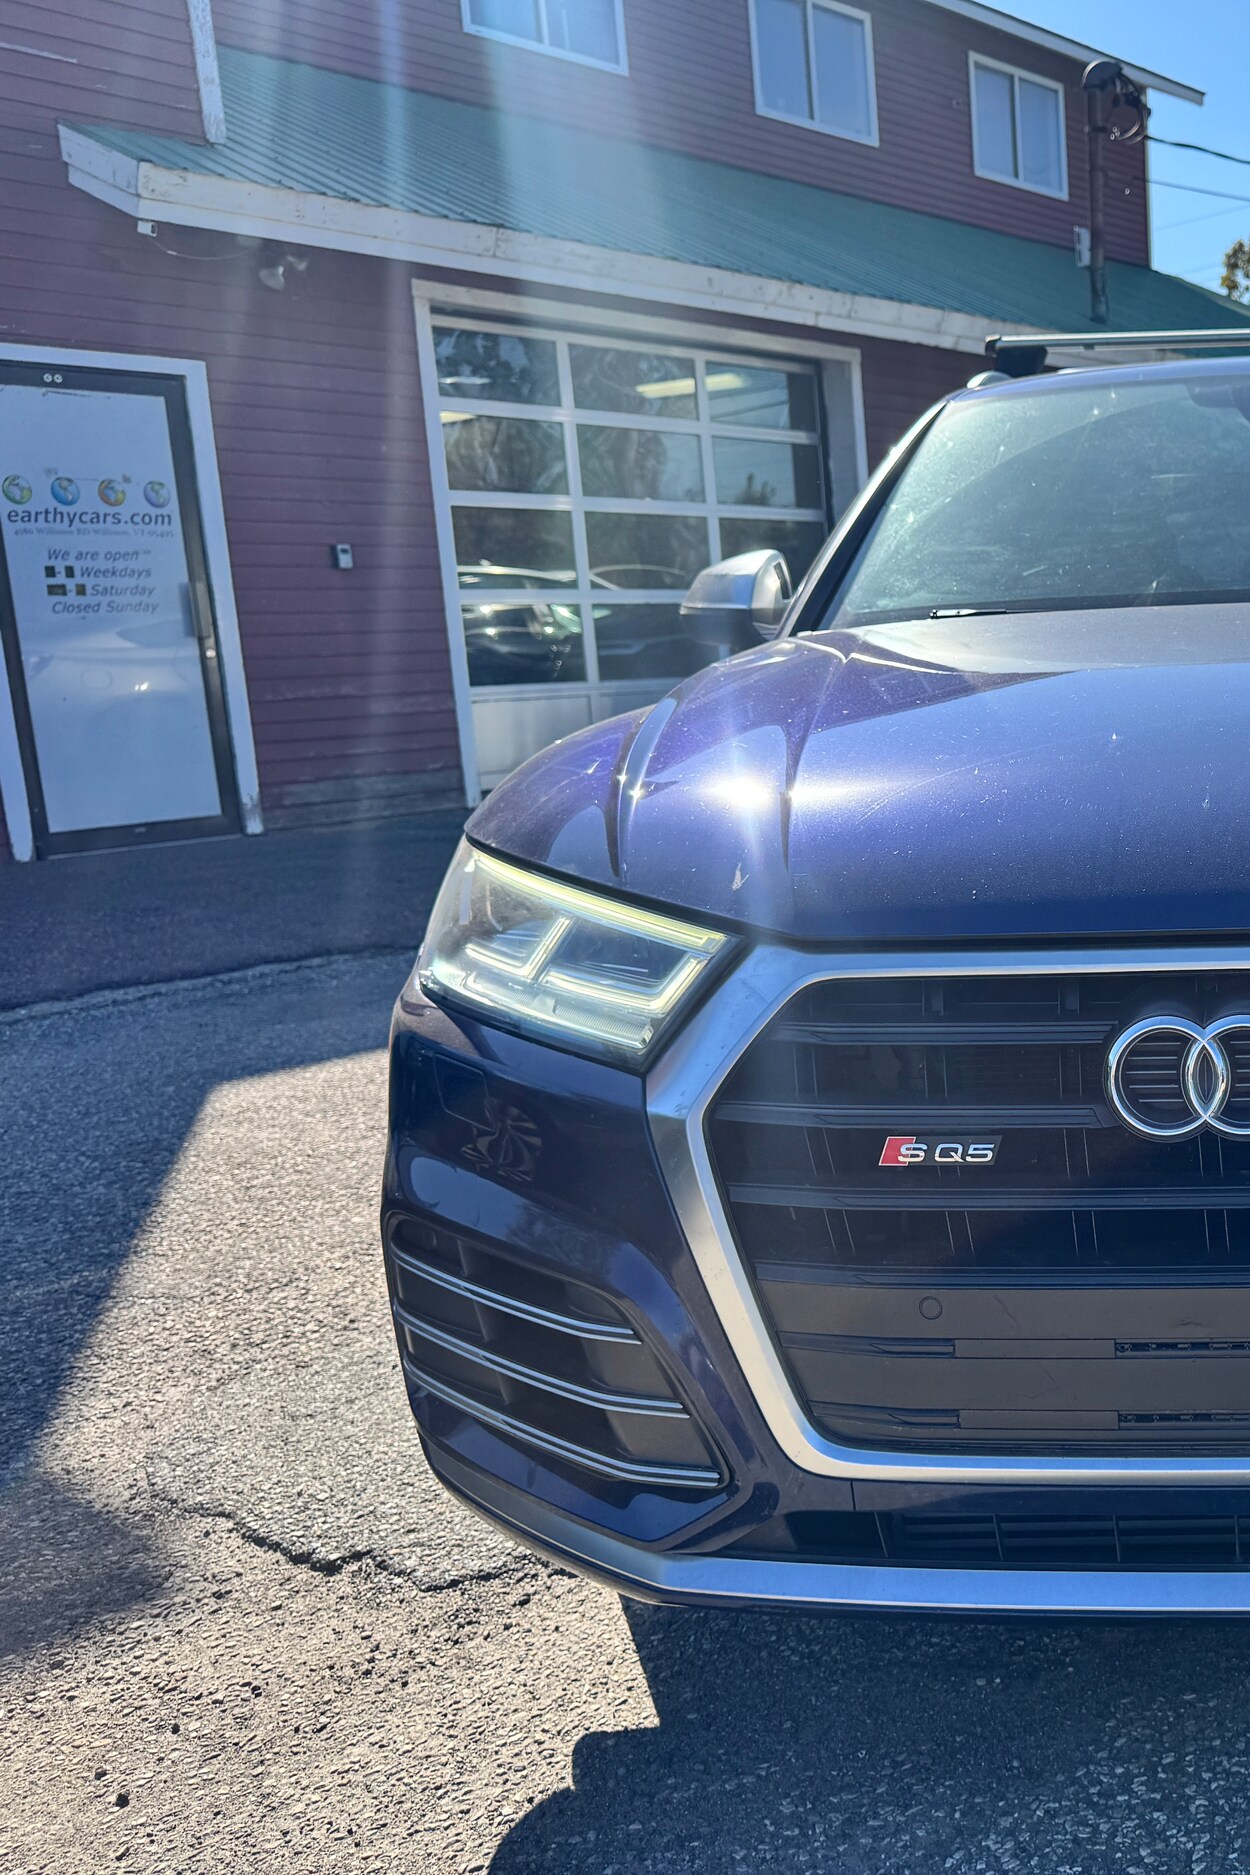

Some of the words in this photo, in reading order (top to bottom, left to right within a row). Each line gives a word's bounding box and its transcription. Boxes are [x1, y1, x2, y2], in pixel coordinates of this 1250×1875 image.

[7, 507, 172, 527] earthycars.com
[47, 549, 70, 560] We
[74, 551, 99, 561] are
[104, 550, 140, 563] open
[80, 566, 152, 580] Weekdays
[91, 584, 155, 598] Saturday
[52, 601, 101, 614] Closed
[106, 601, 158, 614] Sunday
[898, 1143, 995, 1162] SQ5
